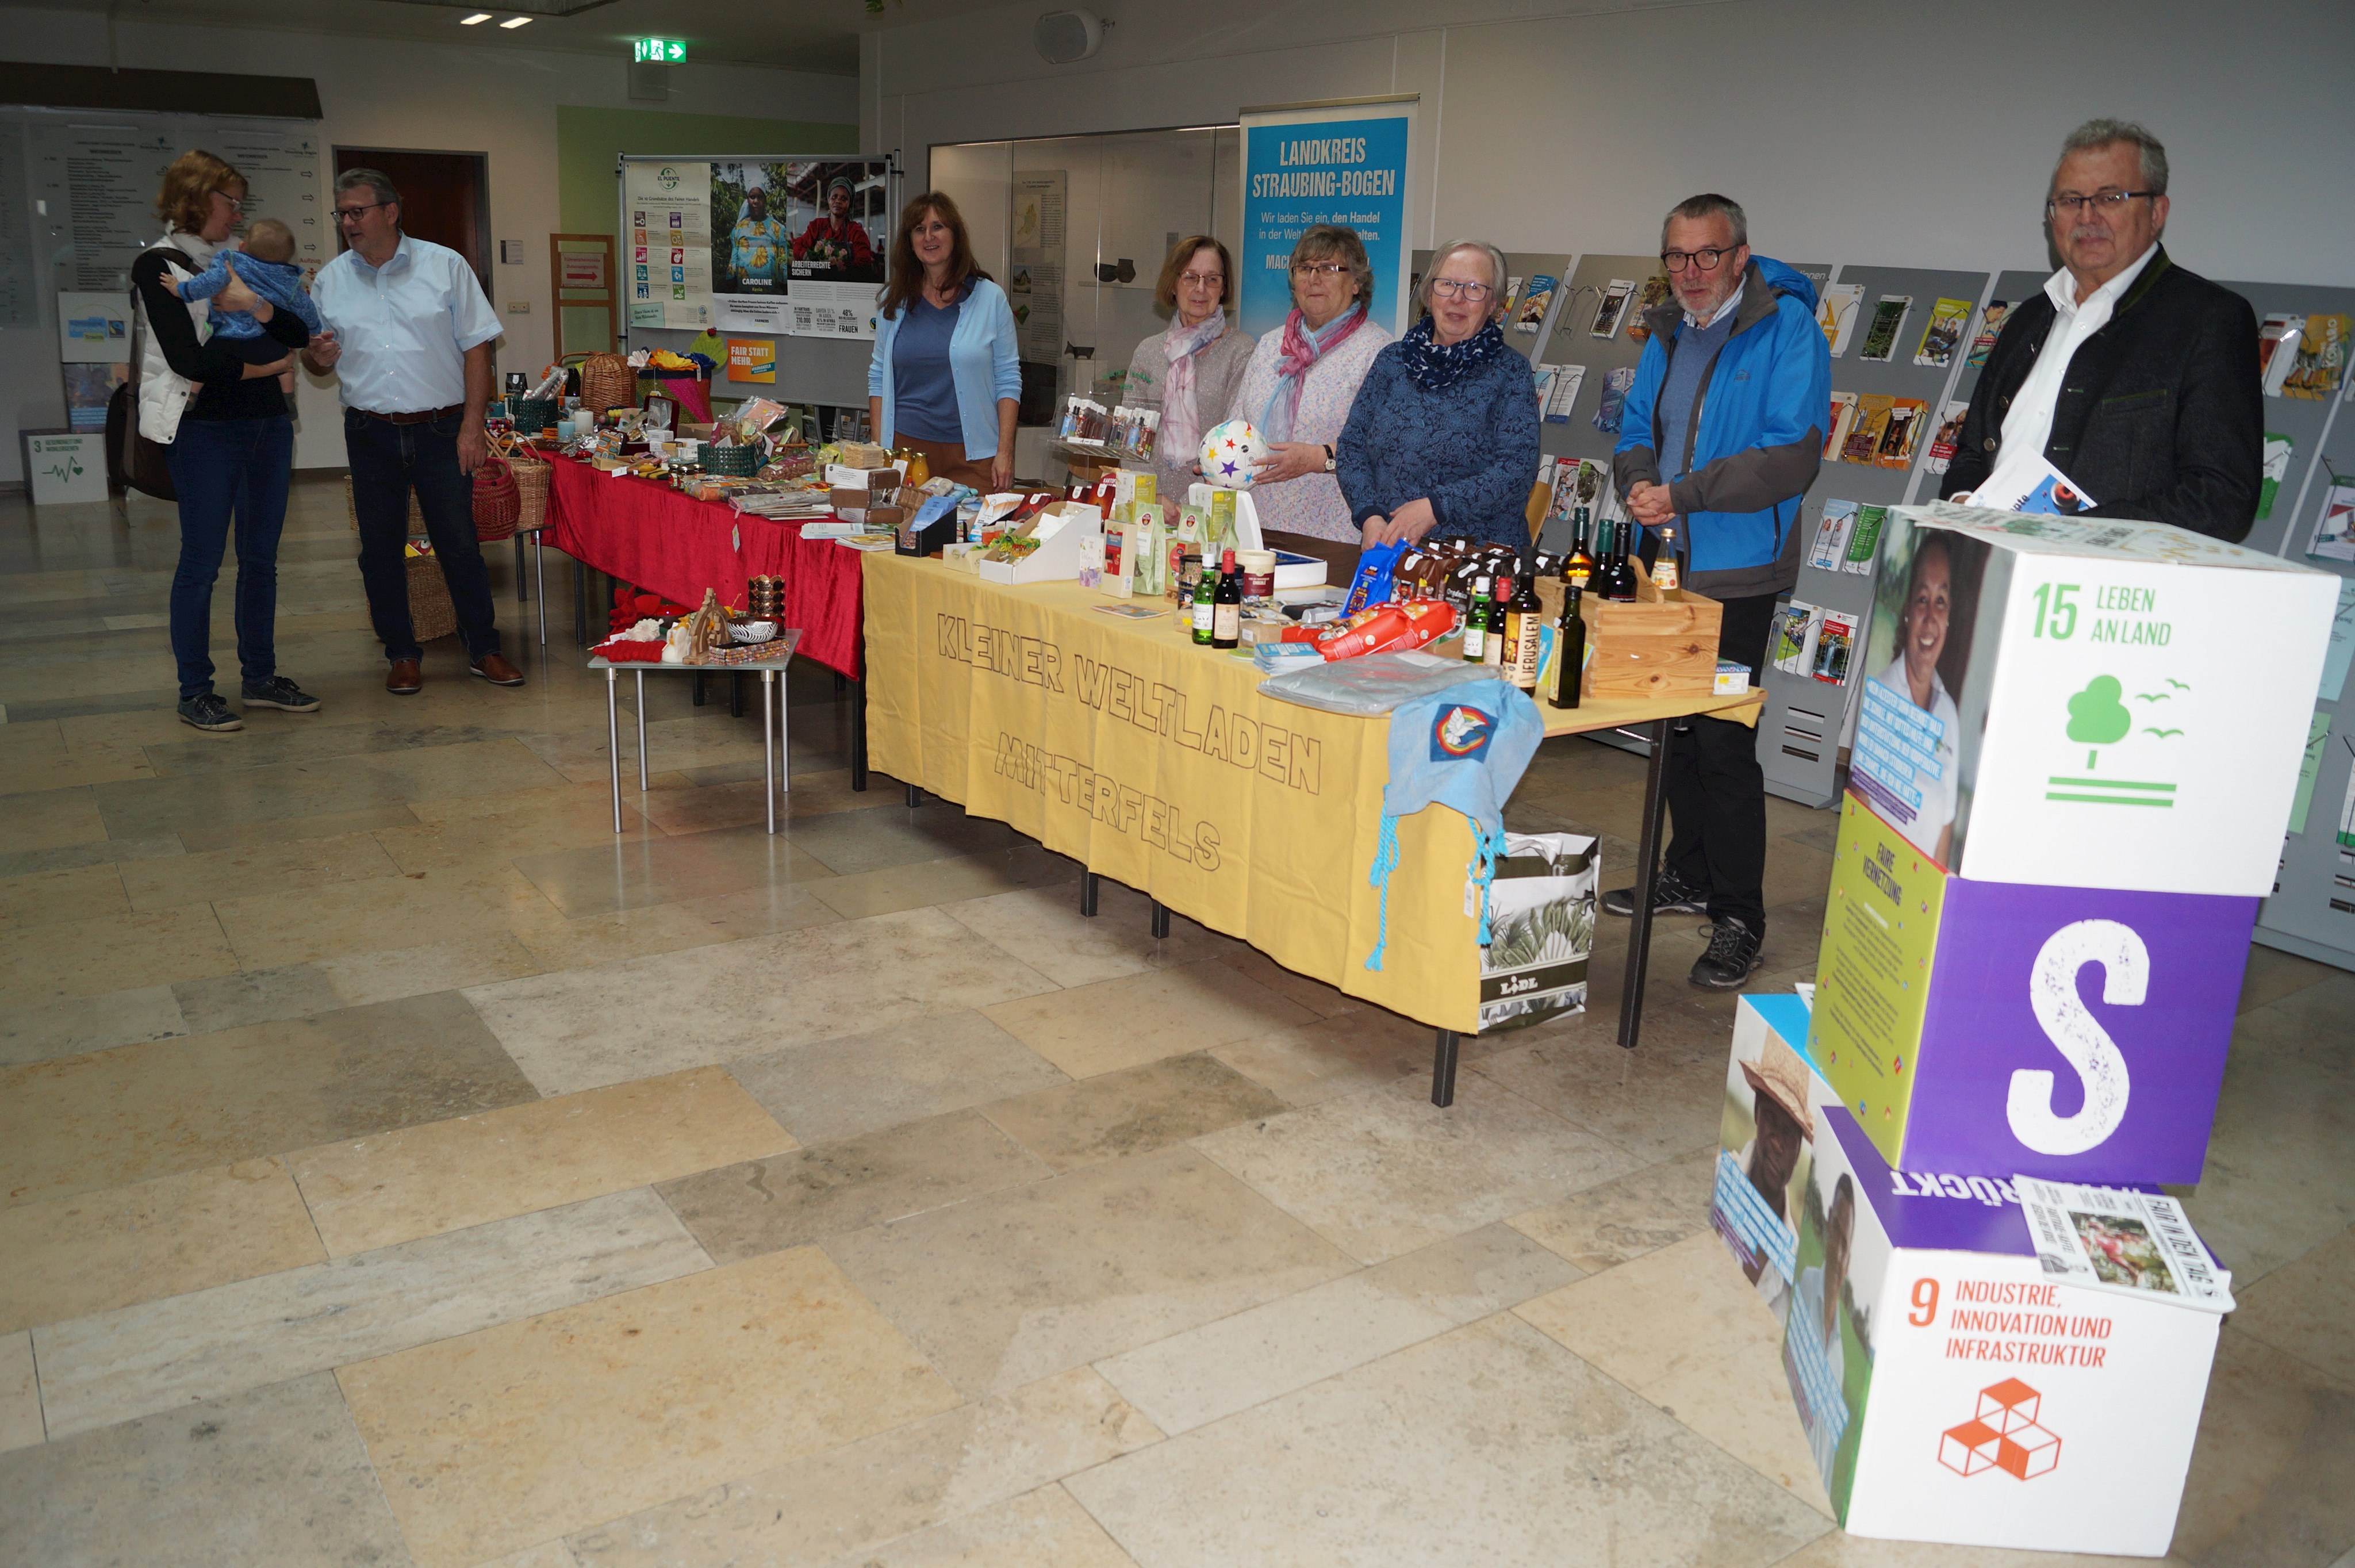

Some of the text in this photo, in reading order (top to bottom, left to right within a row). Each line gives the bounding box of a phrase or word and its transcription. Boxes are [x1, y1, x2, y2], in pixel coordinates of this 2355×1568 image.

[1280, 137, 1366, 166] LANDKREIS
[1252, 170, 1395, 198] STRAUBING-BOGEN
[1261, 211, 1380, 224] Wir laden Sie ein, den Handel
[1259, 229, 1380, 241] in der Welt alten.
[792, 260, 831, 269] ARBEITERRECHTE
[731, 346, 769, 356] FAIR STATT
[731, 356, 753, 366] MEHR.
[34, 440, 41, 453] 3
[2033, 582, 2080, 640] 15
[2096, 585, 2155, 612] LEBEN
[1522, 616, 1539, 674] JERUSALEM
[2091, 619, 2171, 646] AN LAND
[938, 614, 1064, 693] KLEINER
[1075, 655, 1321, 795] WELTLADEN
[995, 732, 1220, 872] MITTERFELS
[1875, 842, 1896, 874] FAIRE
[2007, 919, 2150, 1155] S
[1890, 1170, 2021, 1207] RÜCKT
[1908, 1278, 1940, 1327] 9
[1955, 1280, 2062, 1309] INDUSTRIE,
[1950, 1309, 2112, 1340] INNOVATION UND
[1945, 1337, 2106, 1368] INFRASTRUKTUR
